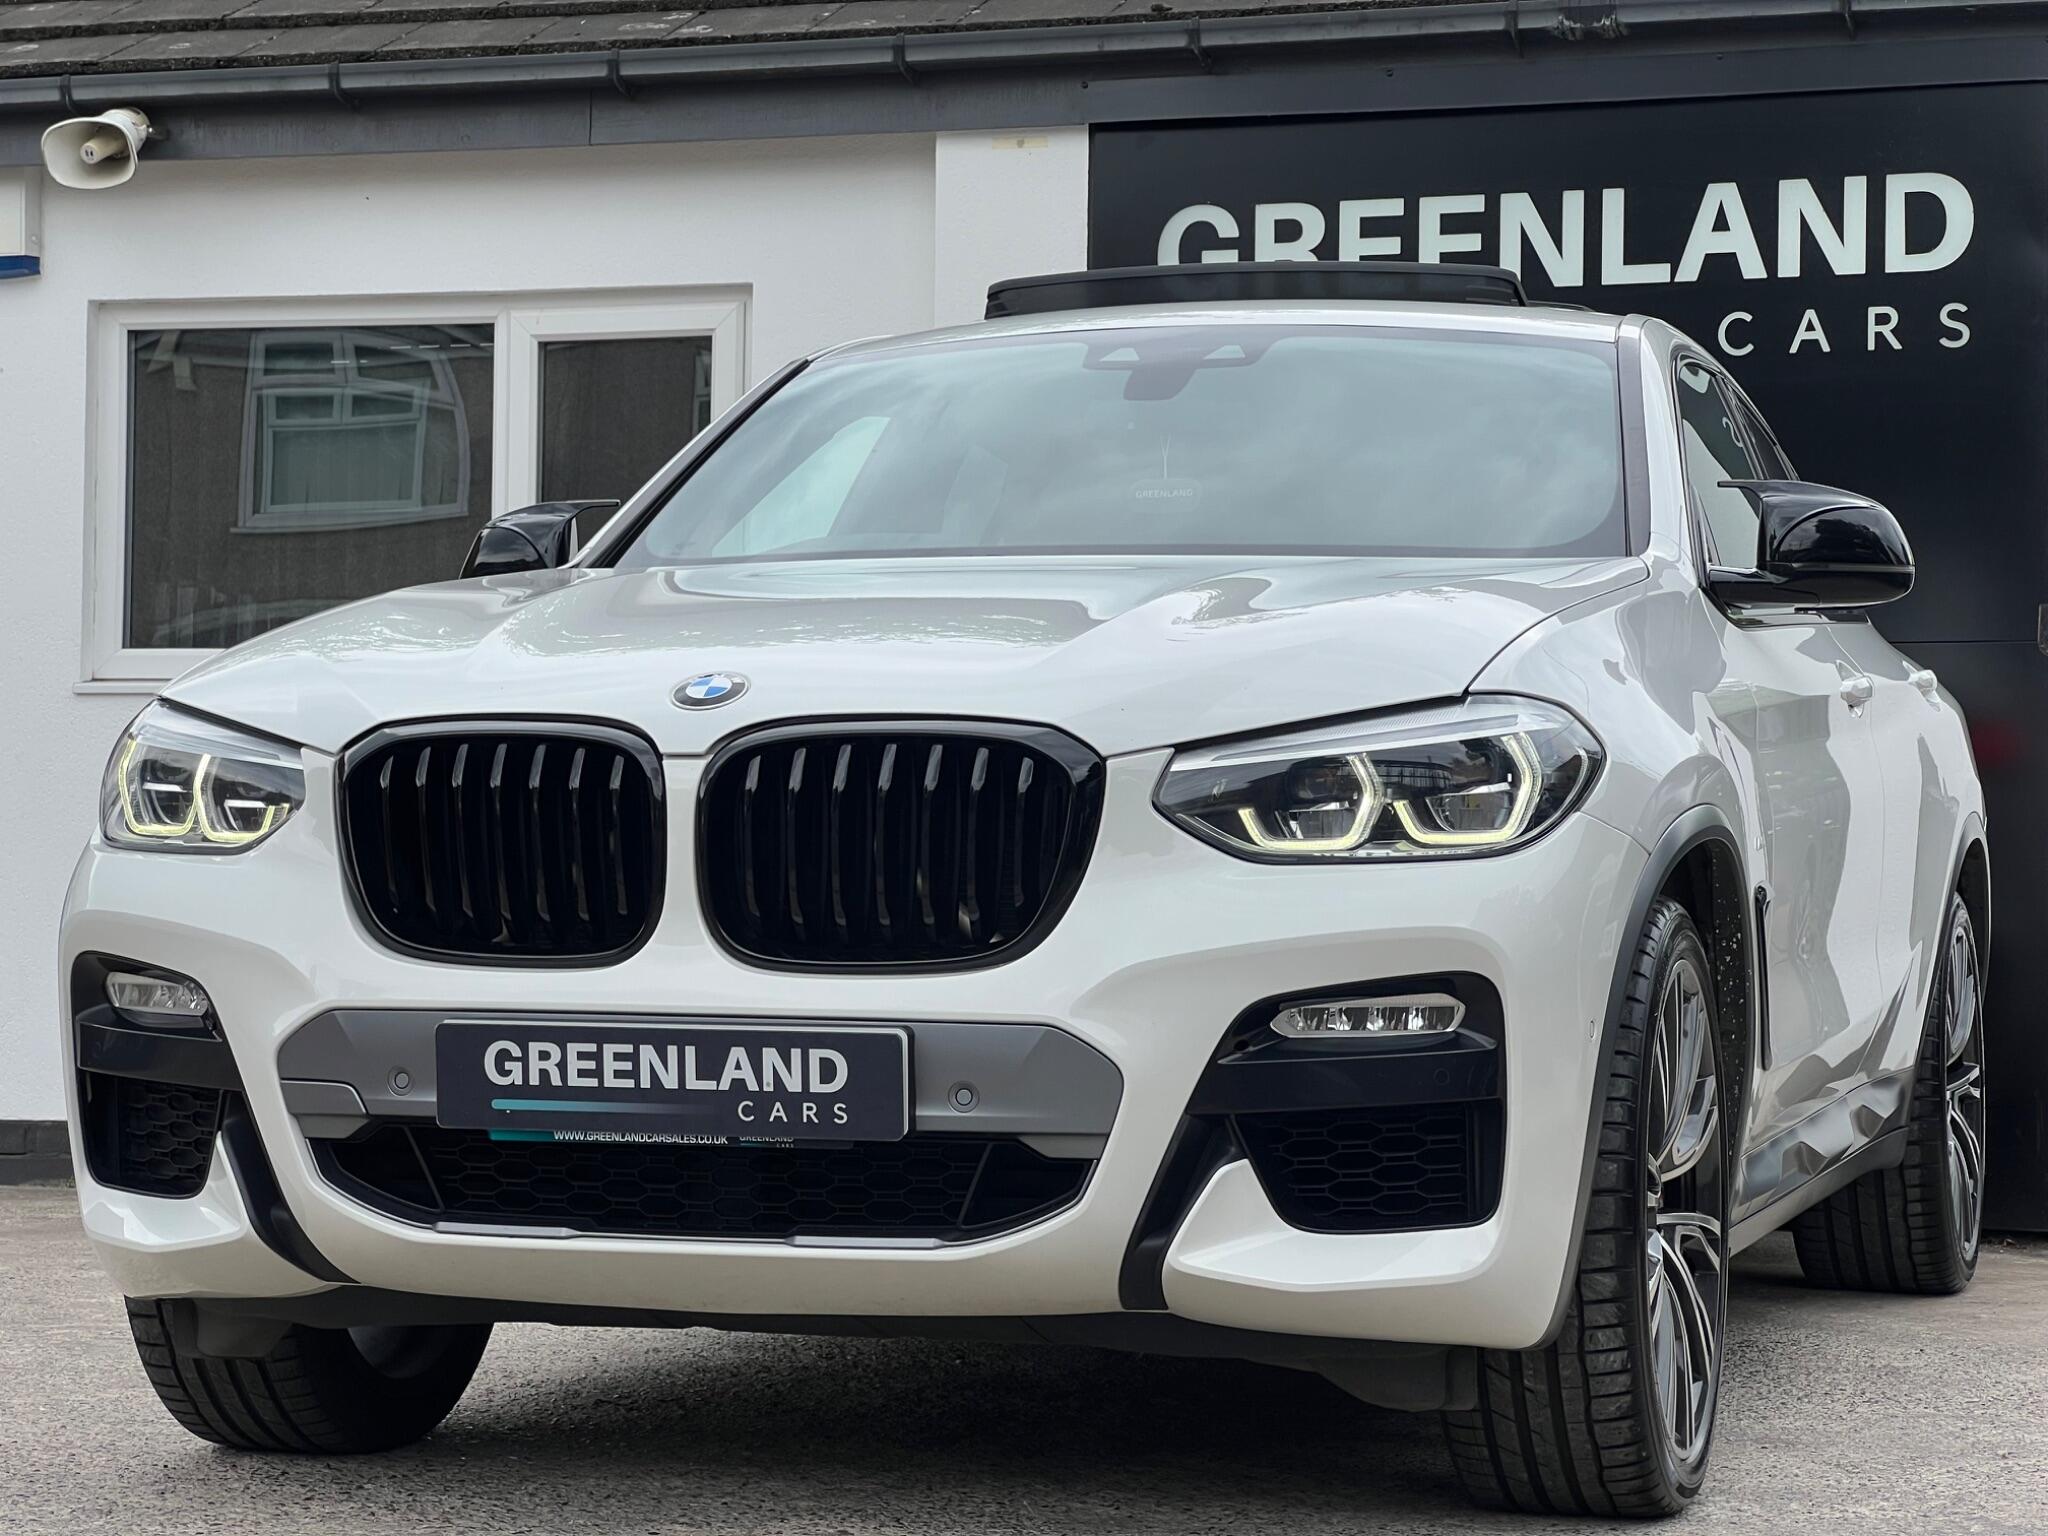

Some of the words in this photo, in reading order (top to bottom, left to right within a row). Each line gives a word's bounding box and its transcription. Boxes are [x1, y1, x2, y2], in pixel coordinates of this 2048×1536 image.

[1157, 172, 1975, 288] GREENLAND
[1717, 302, 1971, 357] CARS
[484, 1040, 849, 1093] GREENLAND
[553, 1130, 729, 1145] WWW.GREENLANDCARSALES.CO.UK
[738, 1100, 848, 1124] CARS
